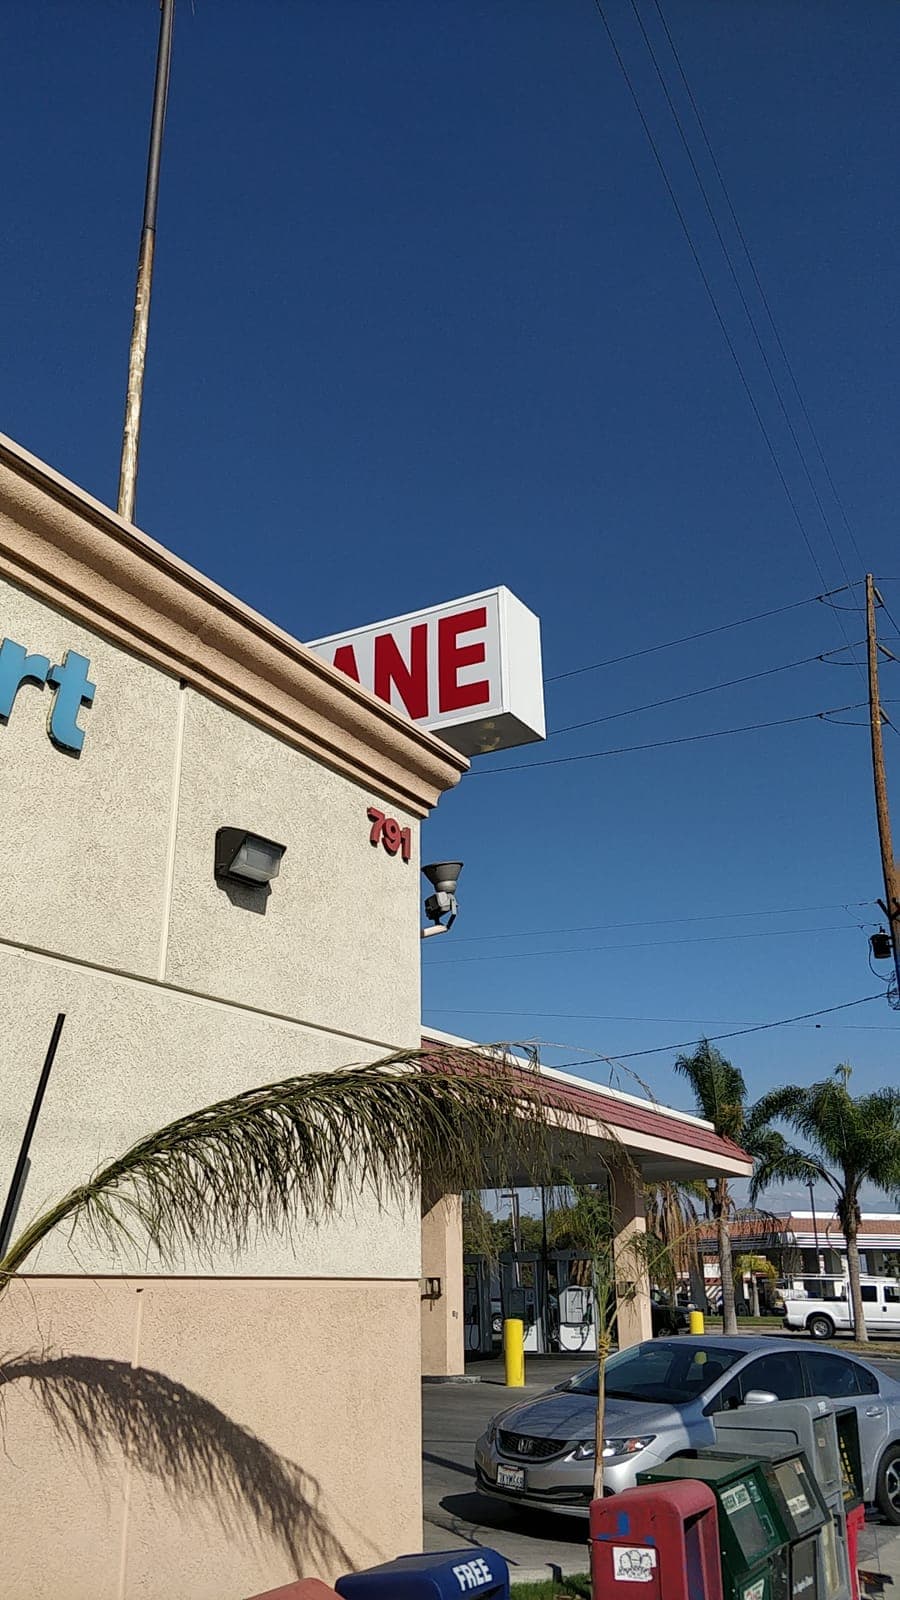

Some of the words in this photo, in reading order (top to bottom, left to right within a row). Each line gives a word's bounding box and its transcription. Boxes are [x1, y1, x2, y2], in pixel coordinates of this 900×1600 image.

[0, 637, 97, 758] rt
[367, 806, 411, 864] 791
[452, 1558, 492, 1592] FREE
